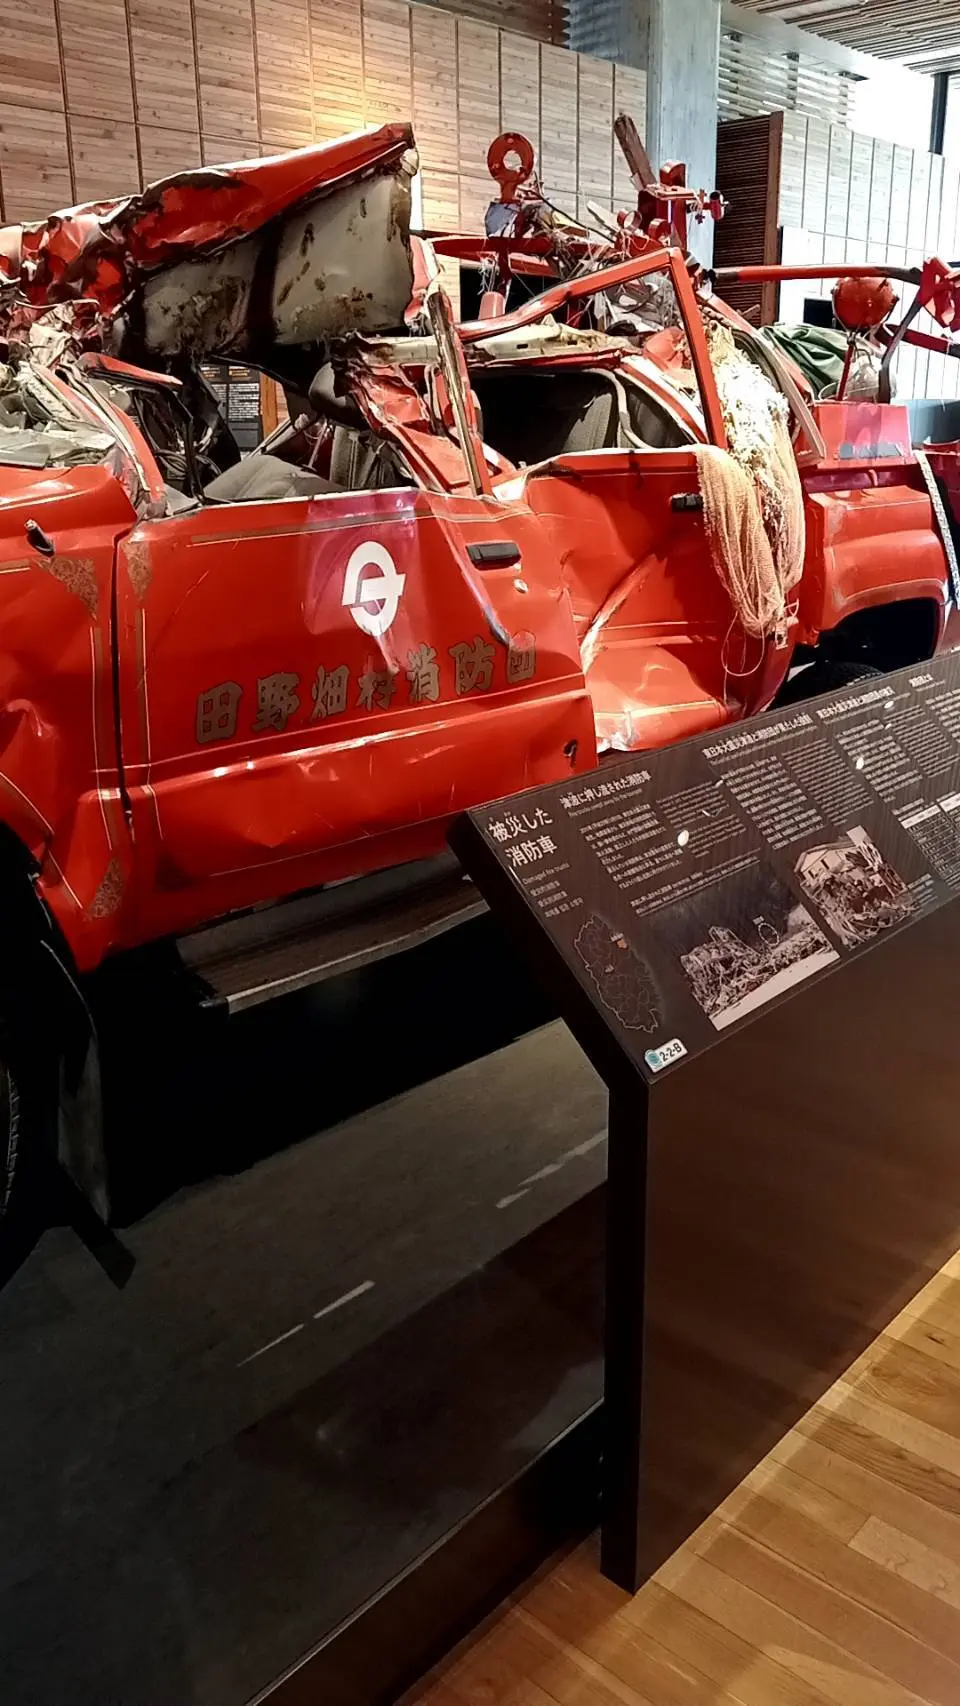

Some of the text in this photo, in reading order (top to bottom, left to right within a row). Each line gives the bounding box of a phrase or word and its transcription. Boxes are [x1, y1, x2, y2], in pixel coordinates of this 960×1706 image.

[195, 629, 537, 744] 田野畑村消防団
[488, 807, 554, 843] 被災した
[504, 835, 558, 868] 消防車
